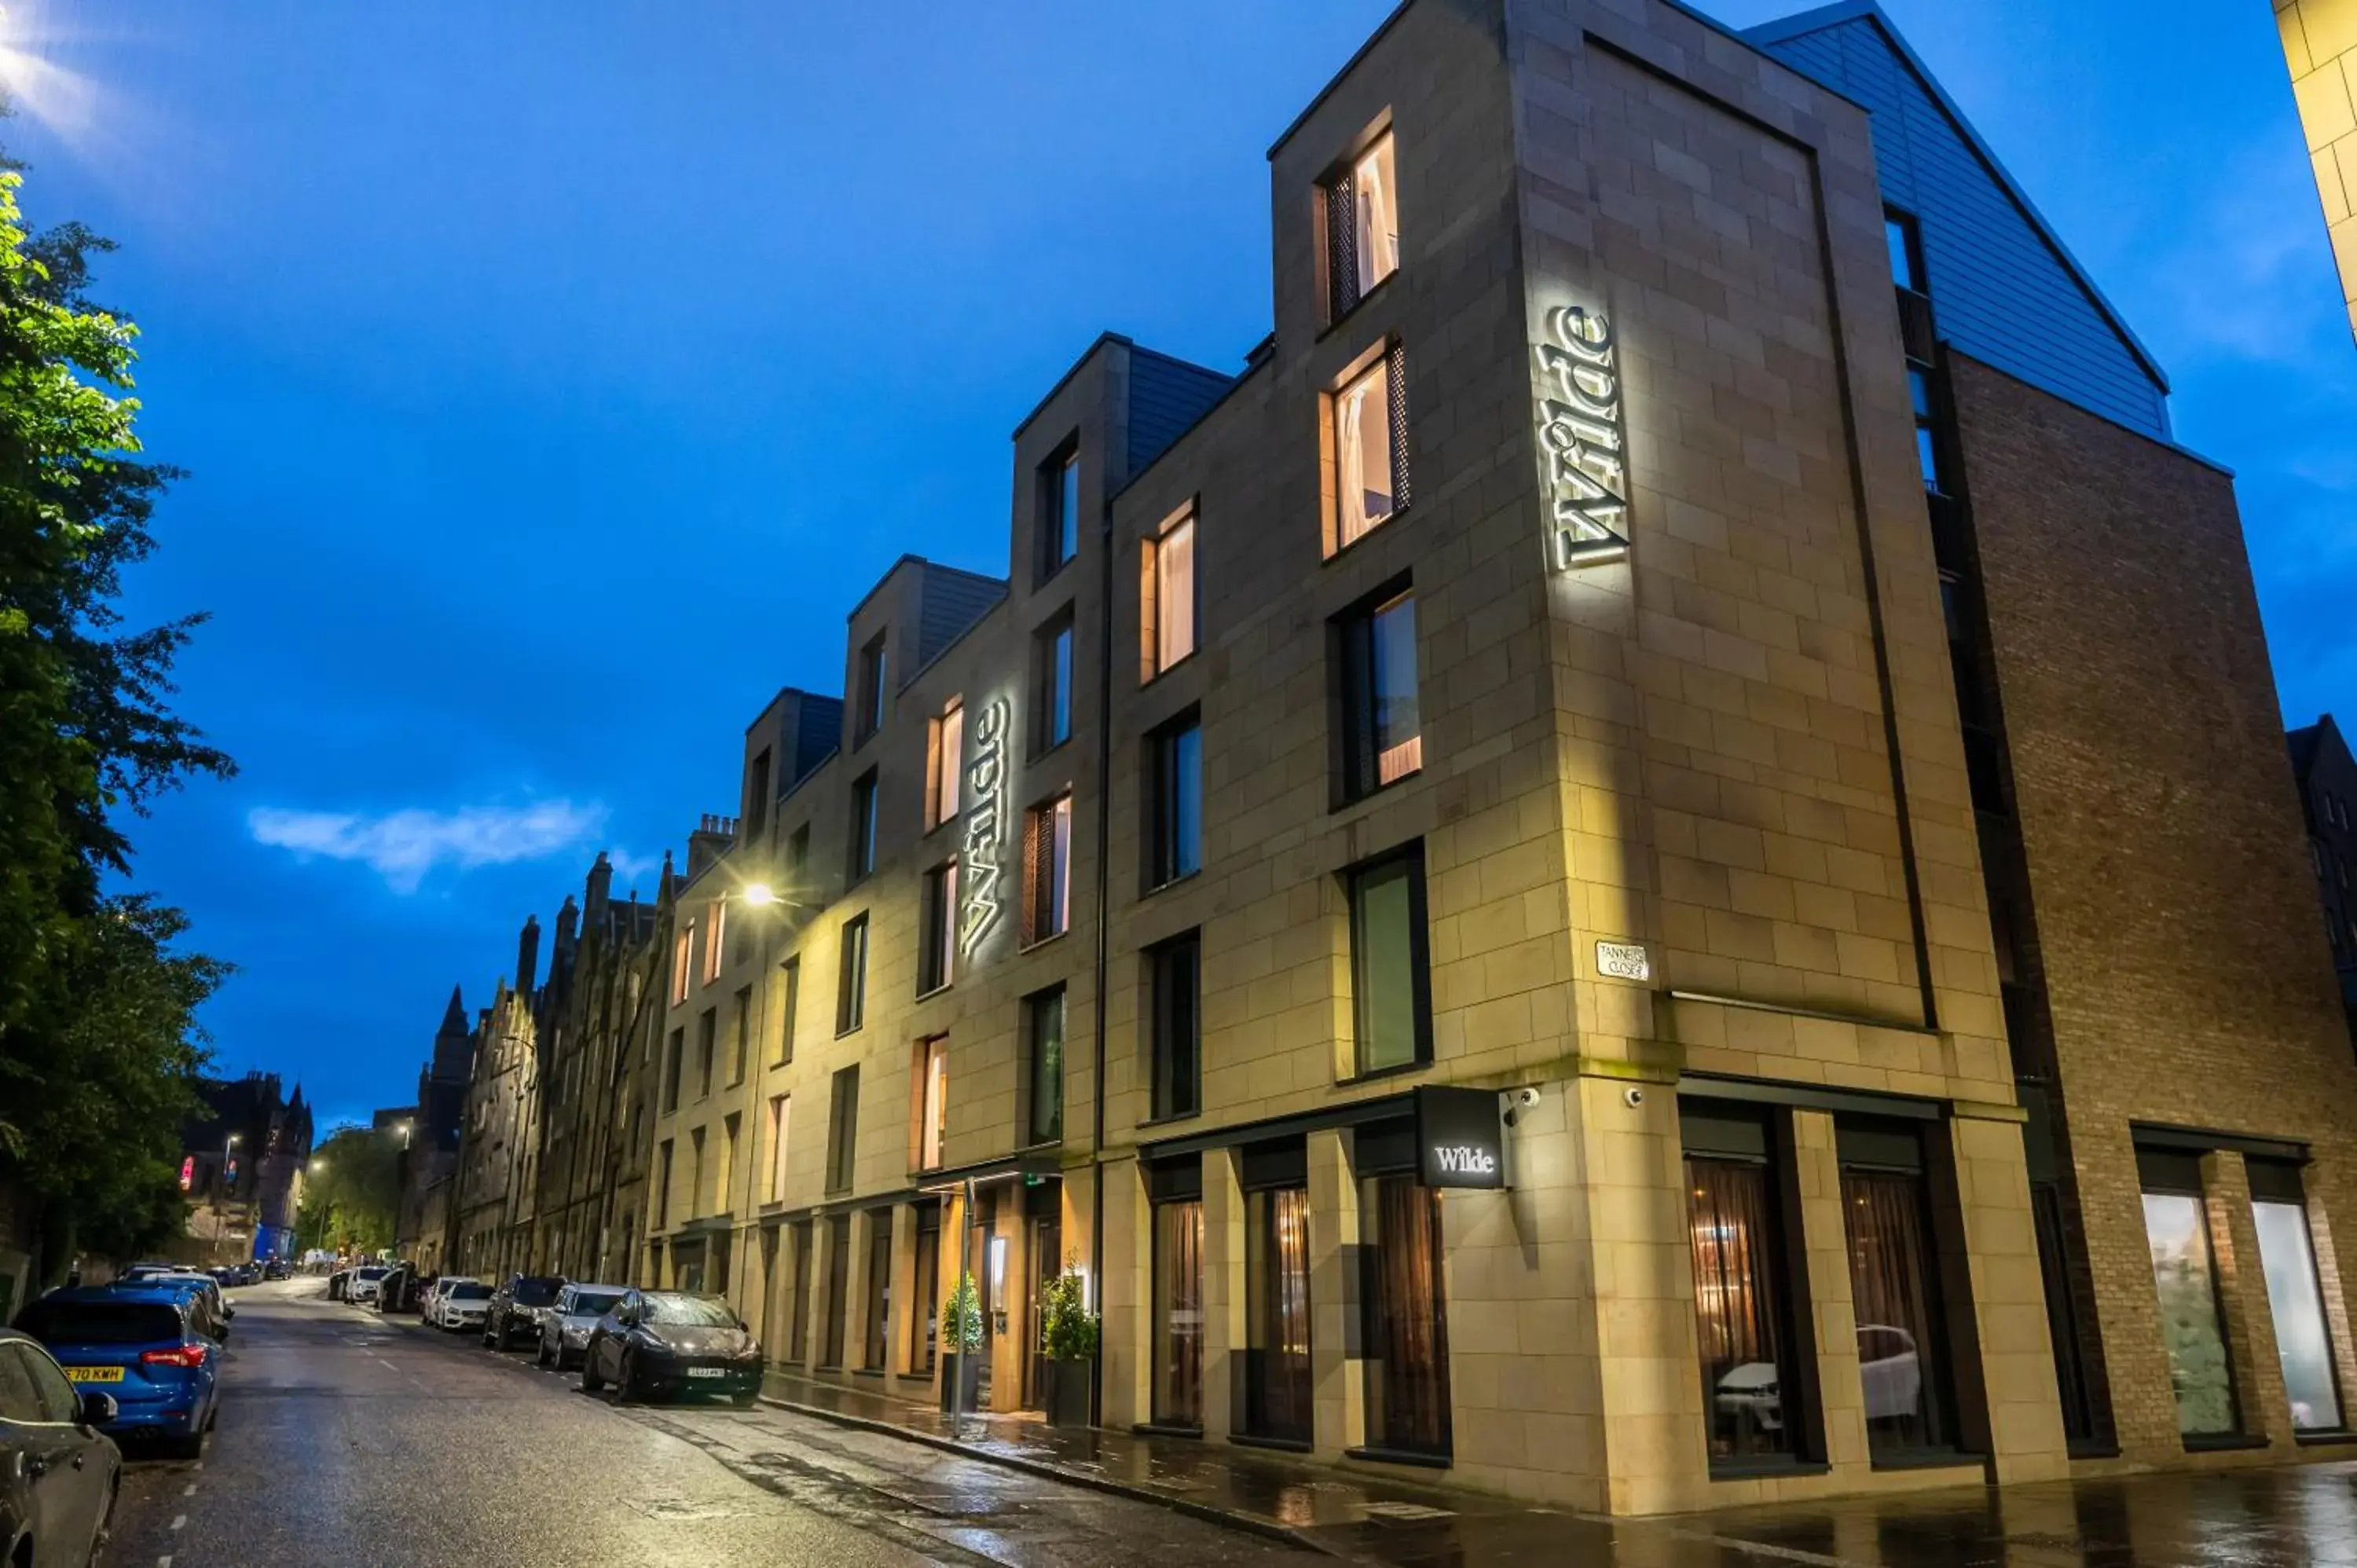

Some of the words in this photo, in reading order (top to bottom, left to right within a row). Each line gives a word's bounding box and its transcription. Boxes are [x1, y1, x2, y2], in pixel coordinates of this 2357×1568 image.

[1535, 306, 1630, 570] Wilde
[960, 696, 1010, 958] Wilde
[1434, 1146, 1494, 1173] Wilde
